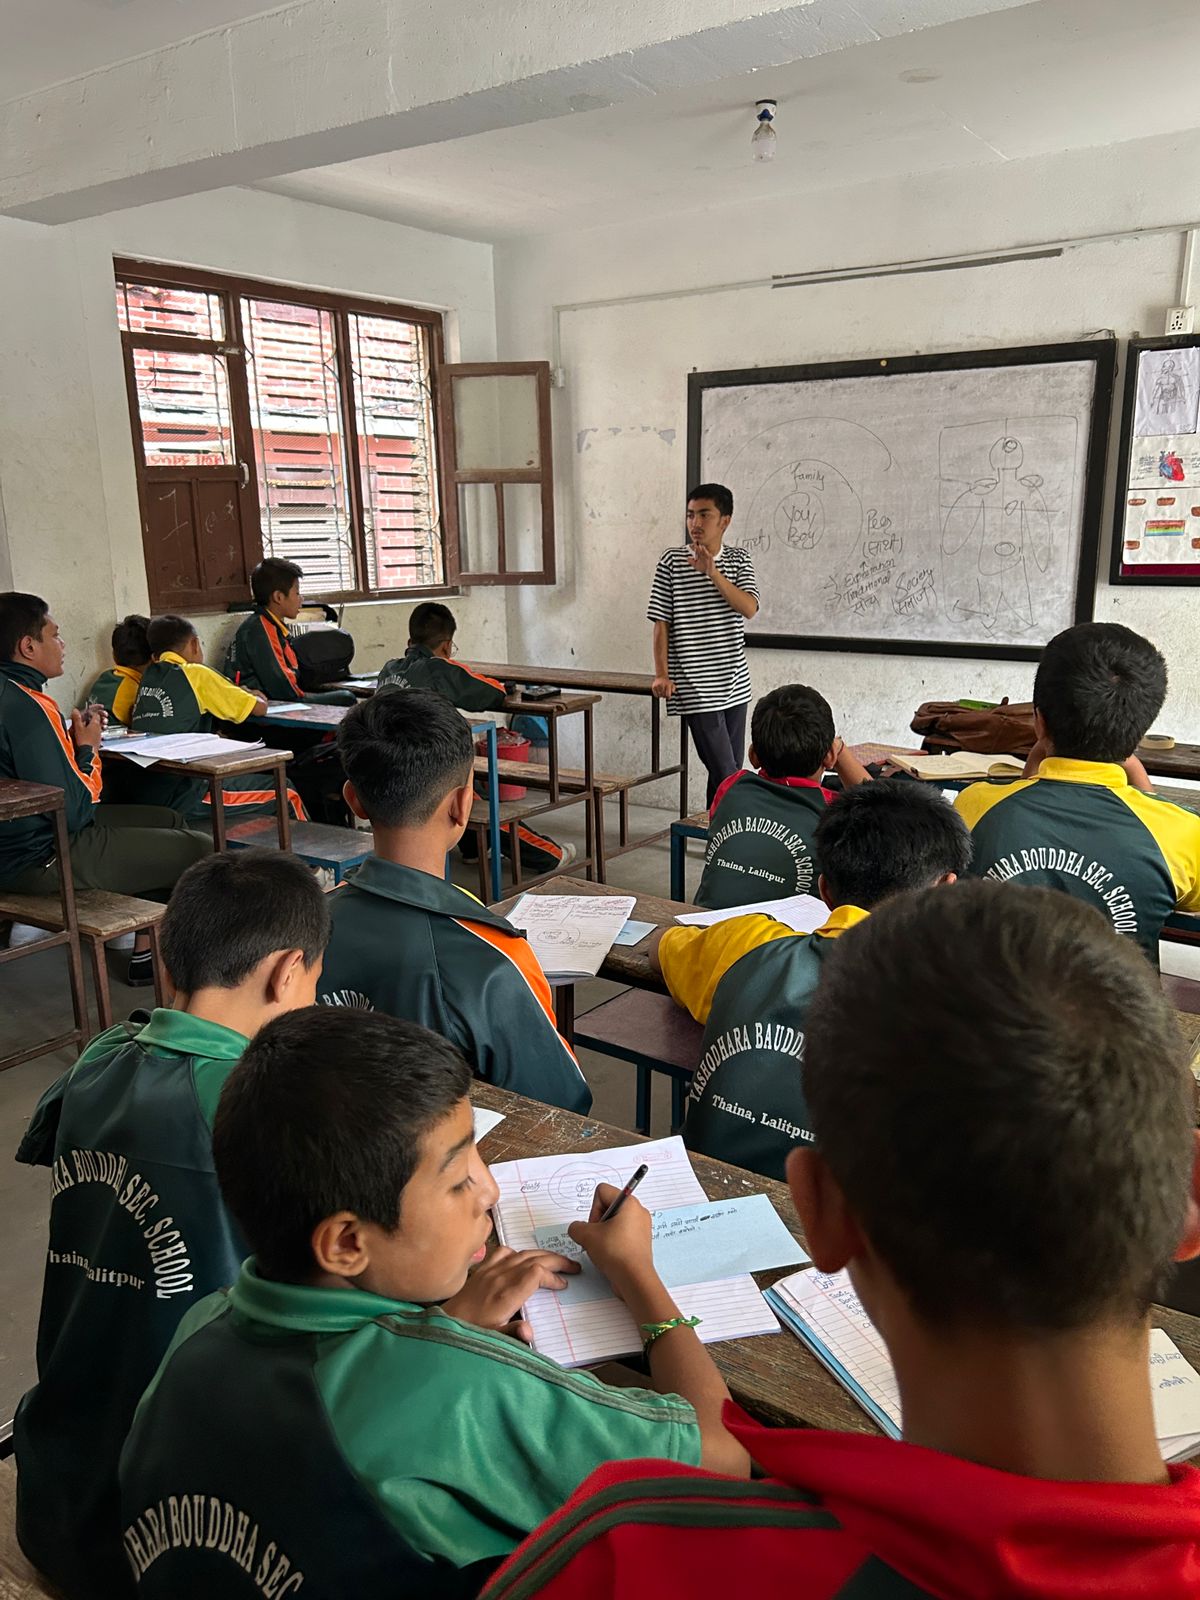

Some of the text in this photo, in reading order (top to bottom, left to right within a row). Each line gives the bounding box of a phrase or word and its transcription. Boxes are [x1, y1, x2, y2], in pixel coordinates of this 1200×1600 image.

[717, 859, 786, 884] Thaina, Lalitpur
[745, 817, 790, 842] BAUDDHA
[795, 856, 814, 893] SCHOOL
[1020, 848, 1085, 877] BOUDDHA
[689, 1024, 752, 1102] YASHODHARA
[712, 1094, 817, 1142] Thaina, Lalitpur
[87, 1267, 145, 1290] alitpur
[143, 1216, 194, 1299] SCHOOL
[168, 1494, 259, 1573] BOUDDHA
